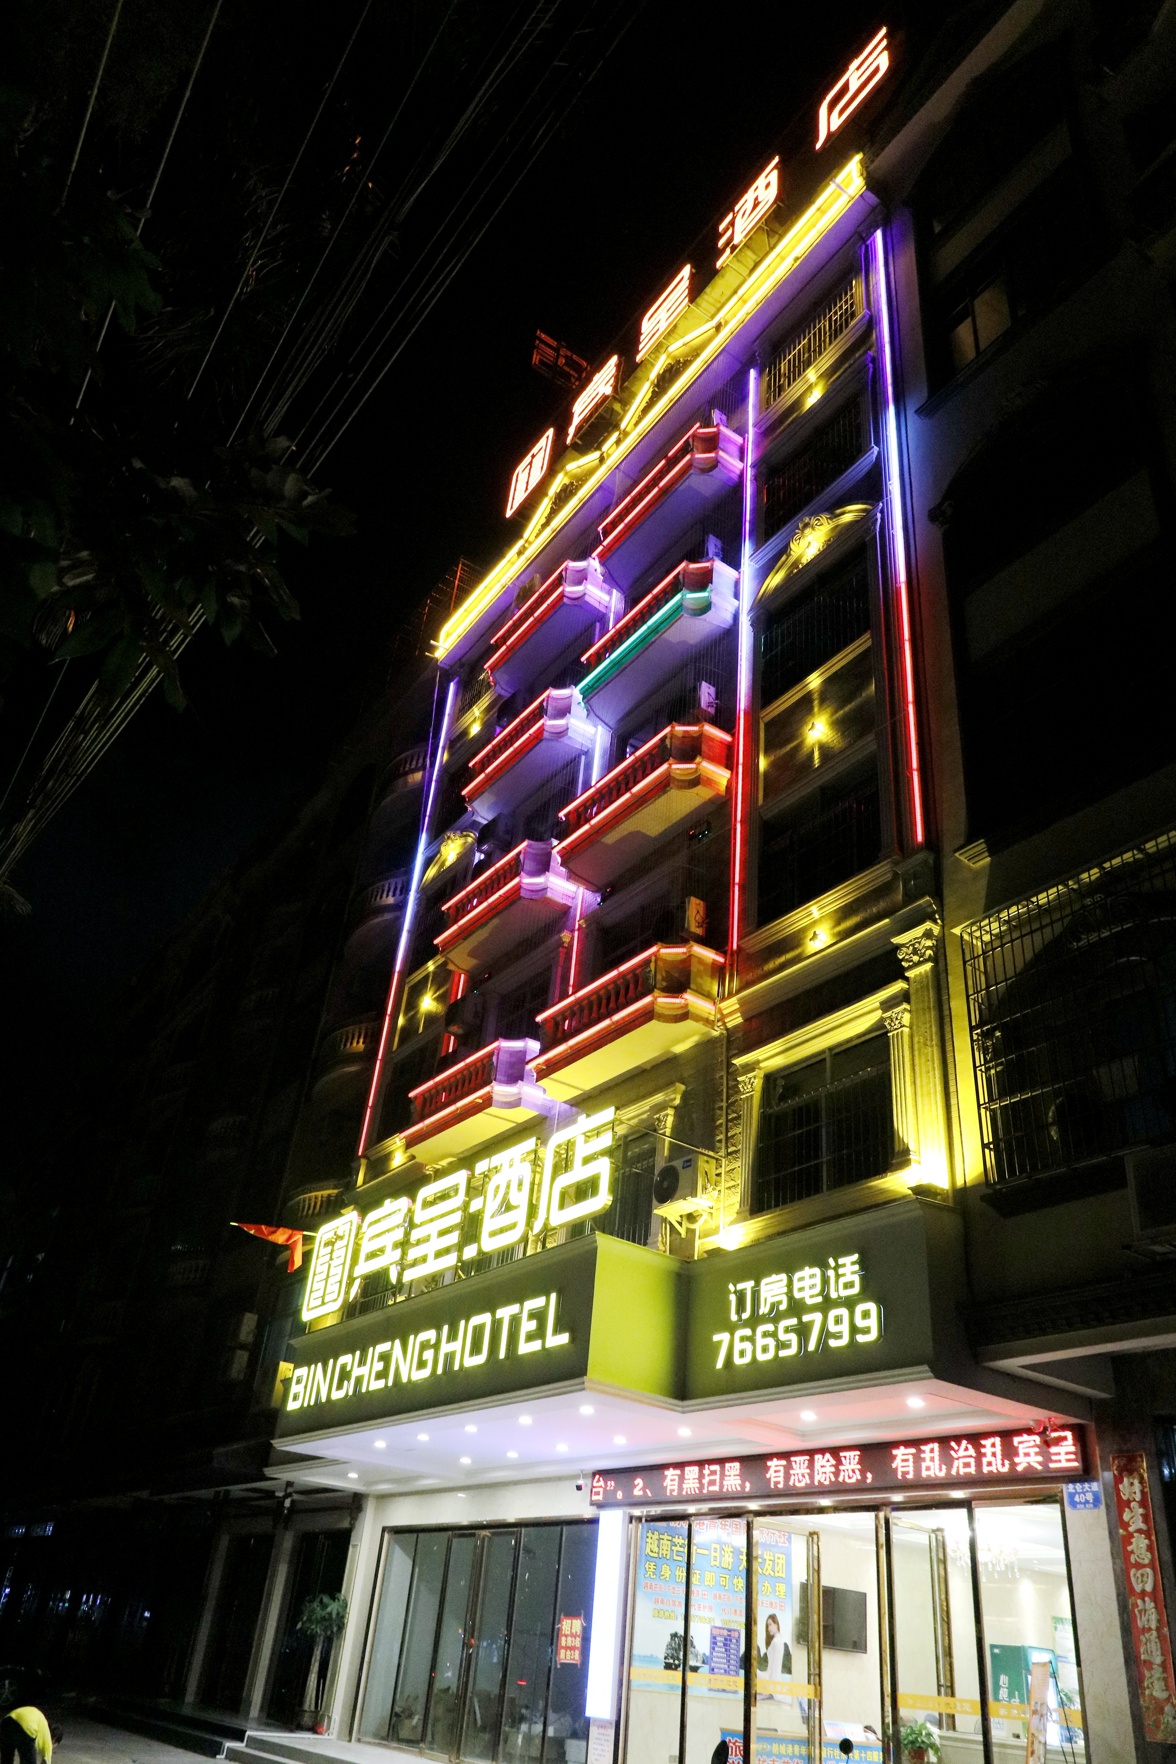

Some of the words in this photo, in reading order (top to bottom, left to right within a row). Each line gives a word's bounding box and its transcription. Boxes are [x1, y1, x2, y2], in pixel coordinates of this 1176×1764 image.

[728, 1253, 861, 1322] 订房电话
[712, 1301, 879, 1370] 7665799
[1074, 1492, 1094, 1503] 40号
[644, 1560, 787, 1599] 凭身份证即可快办理
[561, 1619, 581, 1635] 招聘
